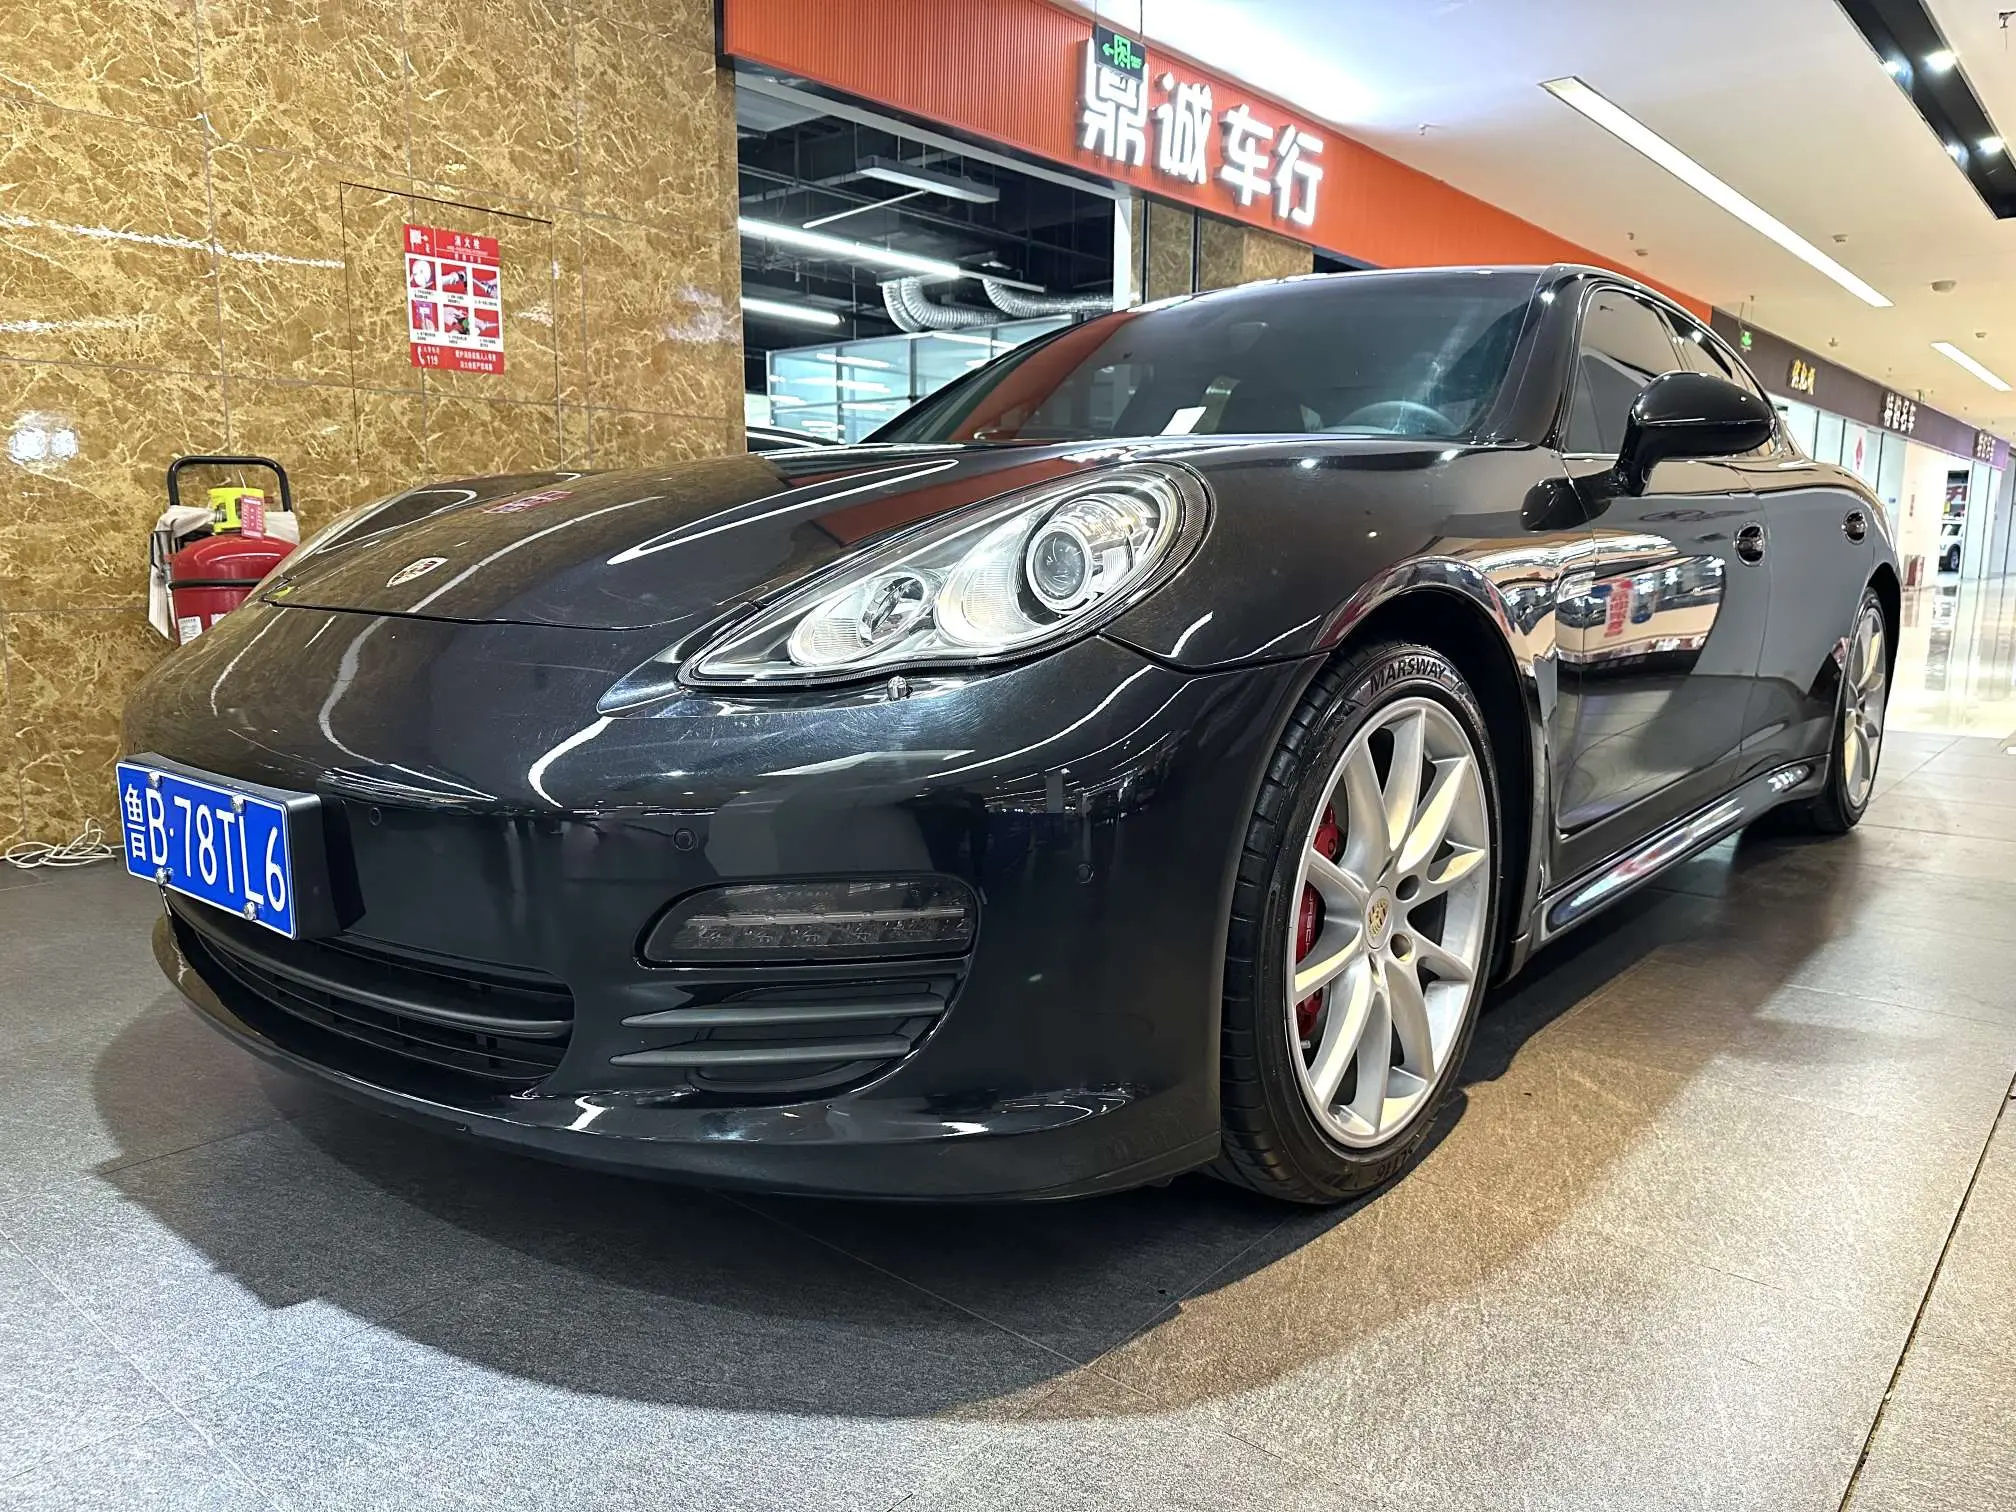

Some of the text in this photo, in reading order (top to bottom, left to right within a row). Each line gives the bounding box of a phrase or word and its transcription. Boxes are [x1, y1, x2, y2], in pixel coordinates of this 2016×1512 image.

[1083, 37, 1324, 226] 鼎诚车行
[426, 355, 439, 366] 119
[1370, 657, 1447, 696] MARSWAY
